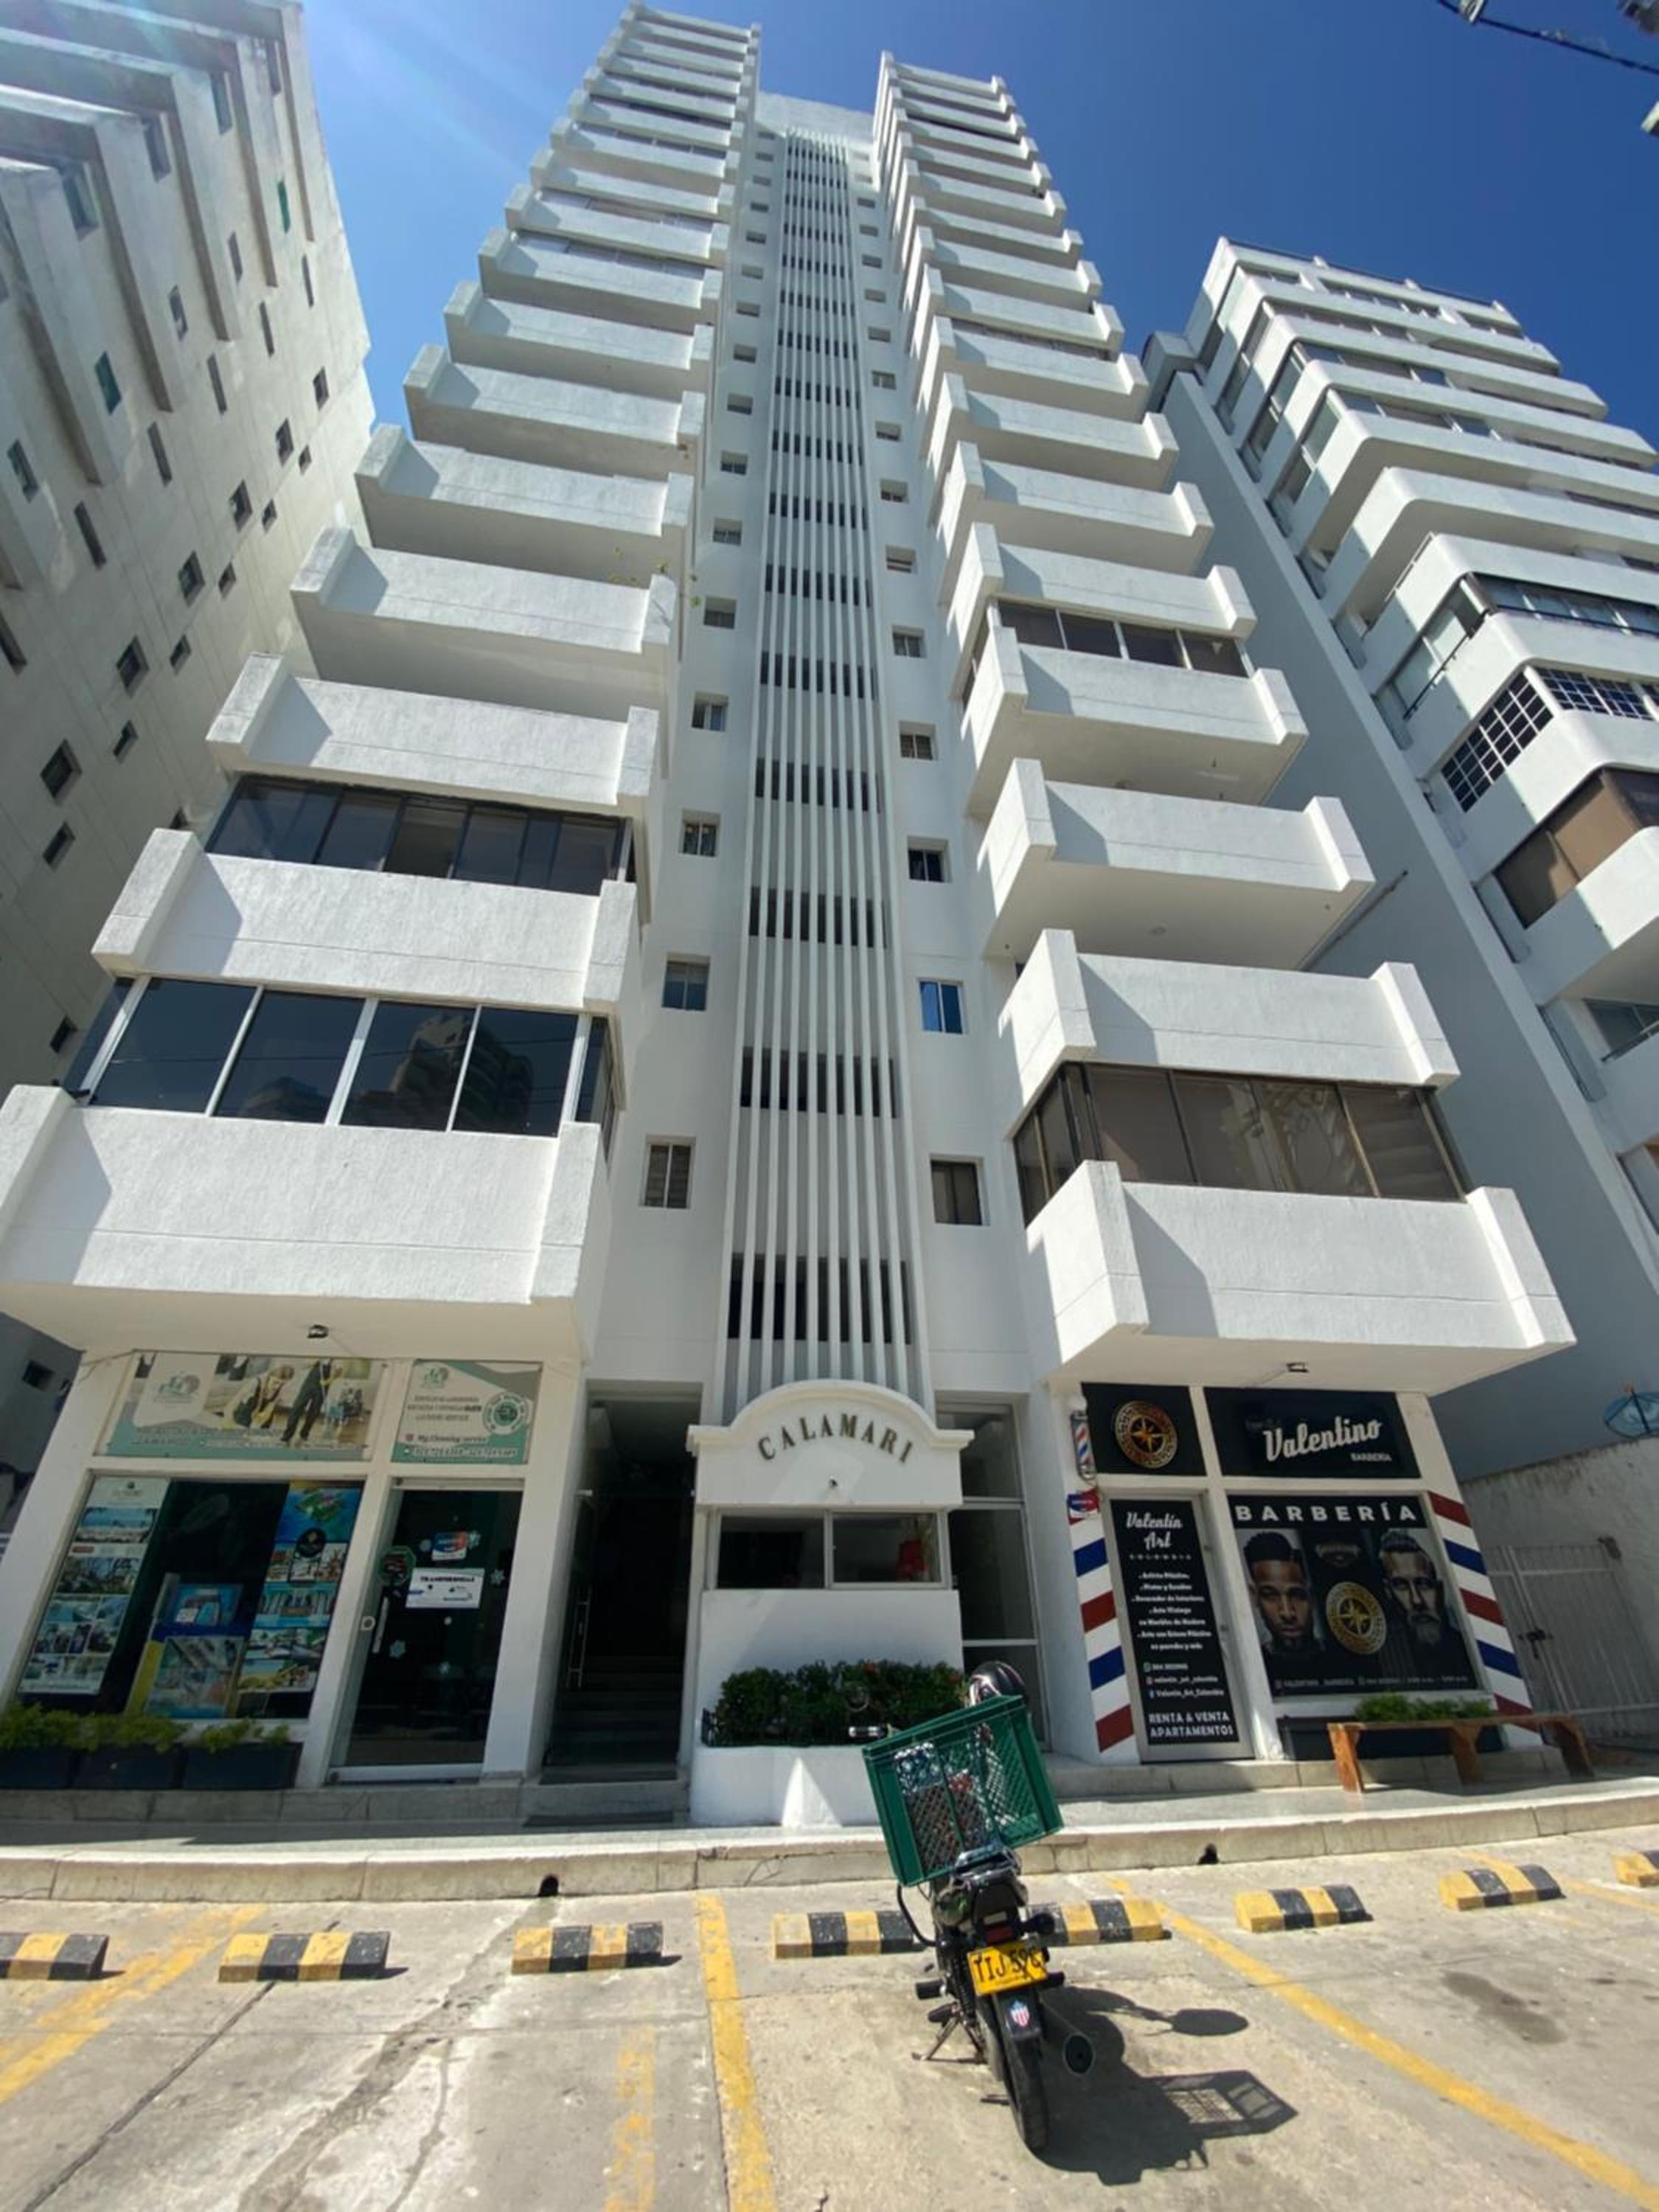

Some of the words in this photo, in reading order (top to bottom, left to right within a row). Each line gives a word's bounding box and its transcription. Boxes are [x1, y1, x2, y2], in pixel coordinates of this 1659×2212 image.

[757, 1413, 914, 1464] CALAMARI
[1262, 1415, 1383, 1462] Valentino
[1234, 1502, 1416, 1522] BARBERÍA
[1144, 1531, 1172, 1551] Art
[1149, 1712, 1183, 1724] RENTA
[1194, 1711, 1230, 1722] VENTA
[1150, 1725, 1234, 1737] APARTAMENTOS
